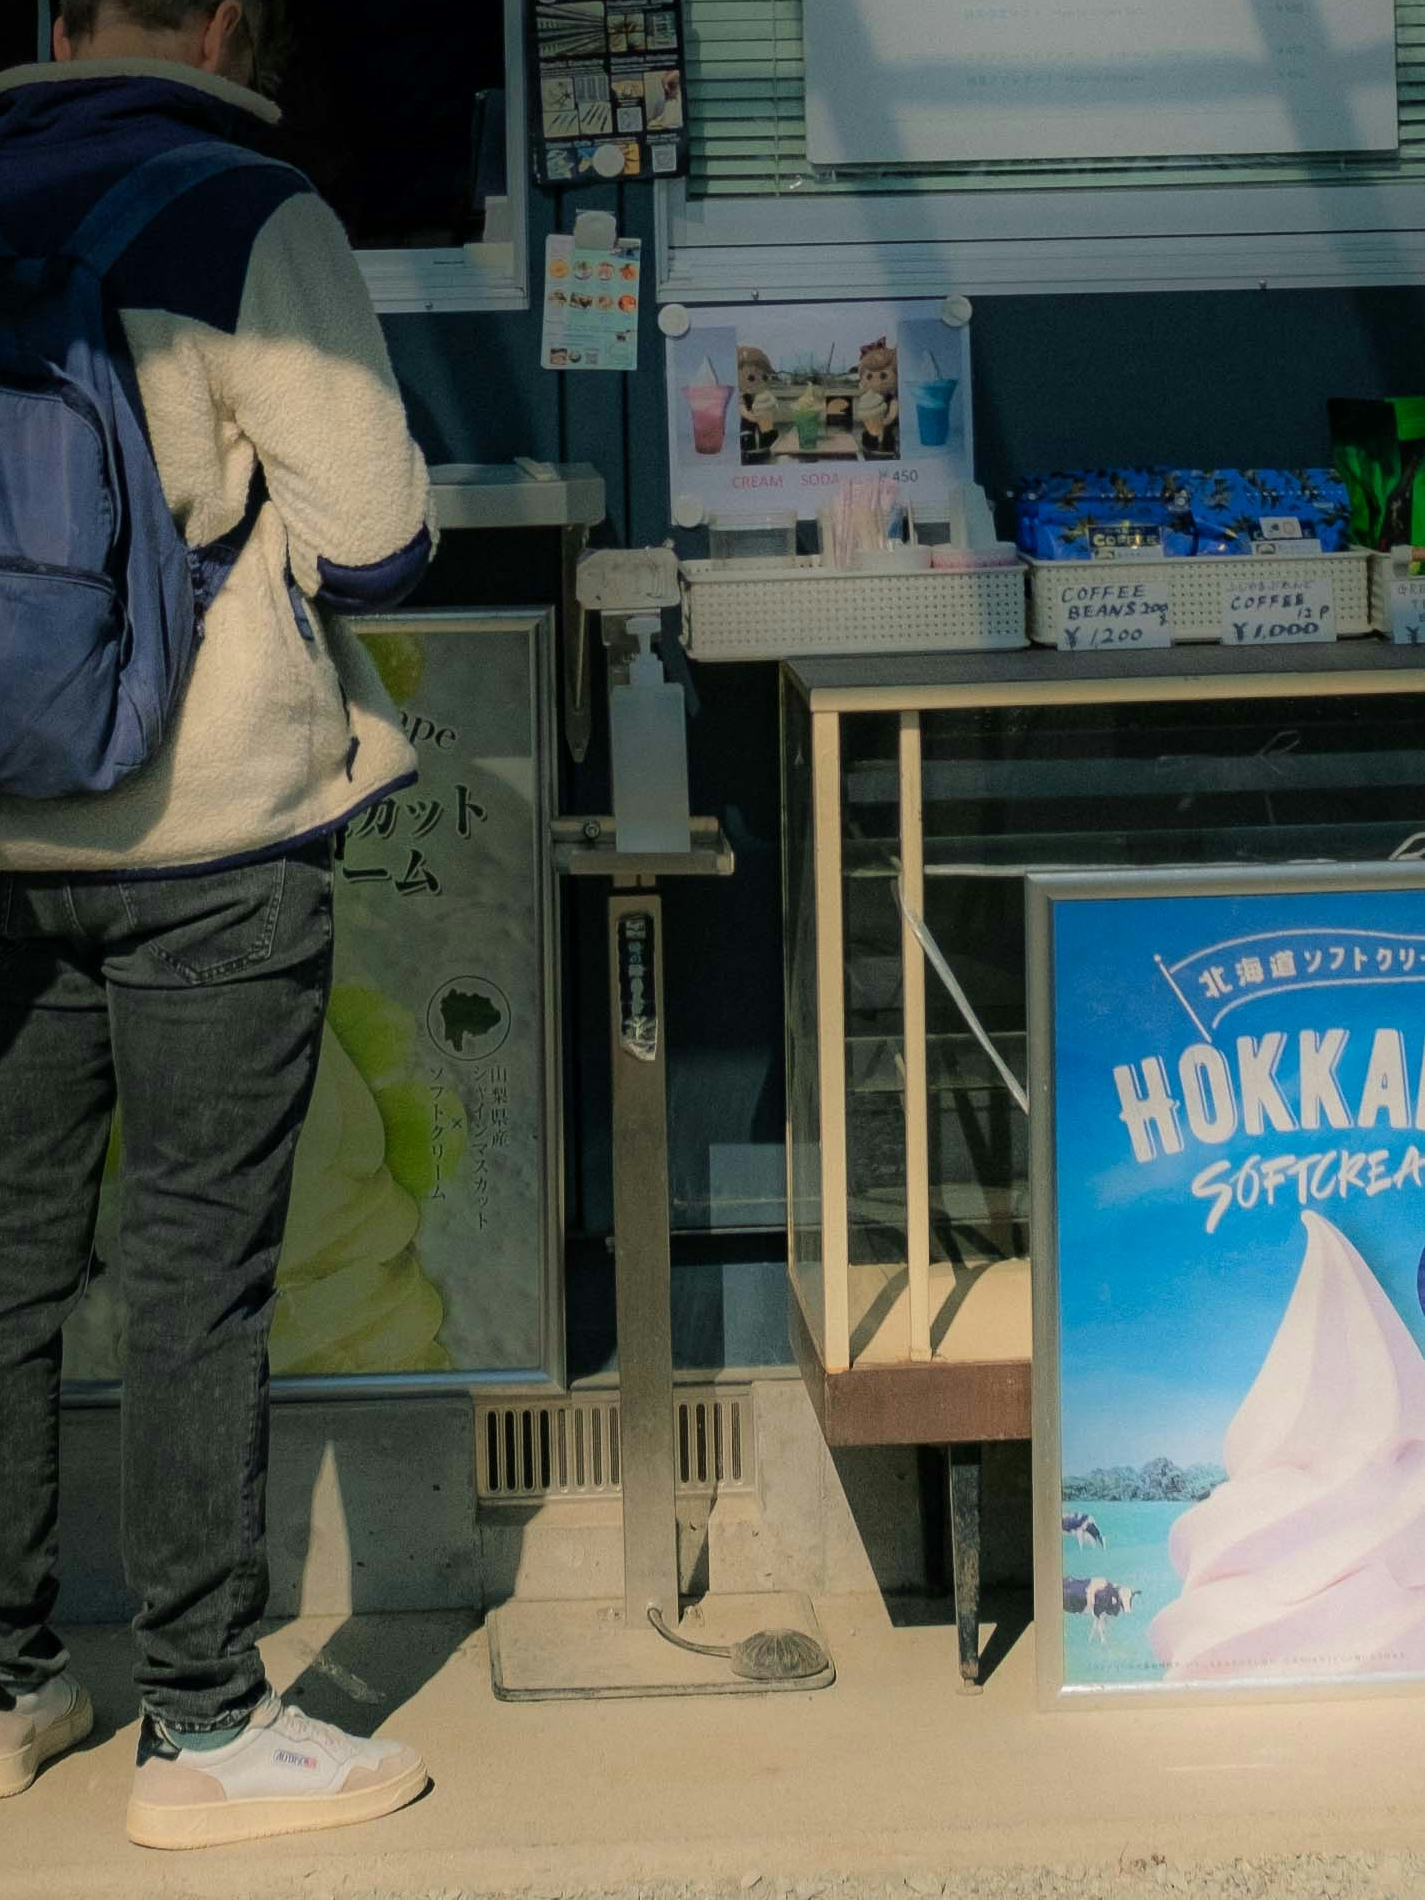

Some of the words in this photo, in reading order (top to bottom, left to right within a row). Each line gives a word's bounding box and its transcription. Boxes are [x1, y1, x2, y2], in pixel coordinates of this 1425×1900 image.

[733, 474, 784, 489] CREAM
[799, 471, 839, 487] SODA
[893, 468, 919, 484] 450
[1062, 583, 1145, 603] COFFEE
[1068, 601, 1137, 621] BEANS
[1231, 593, 1304, 611] COFFEE
[345, 784, 487, 842] カット
[490, 1065, 509, 1149] 山梨県産
[430, 1067, 446, 1201] ソフトクリーム
[473, 1066, 489, 1231] シャインマスカット
